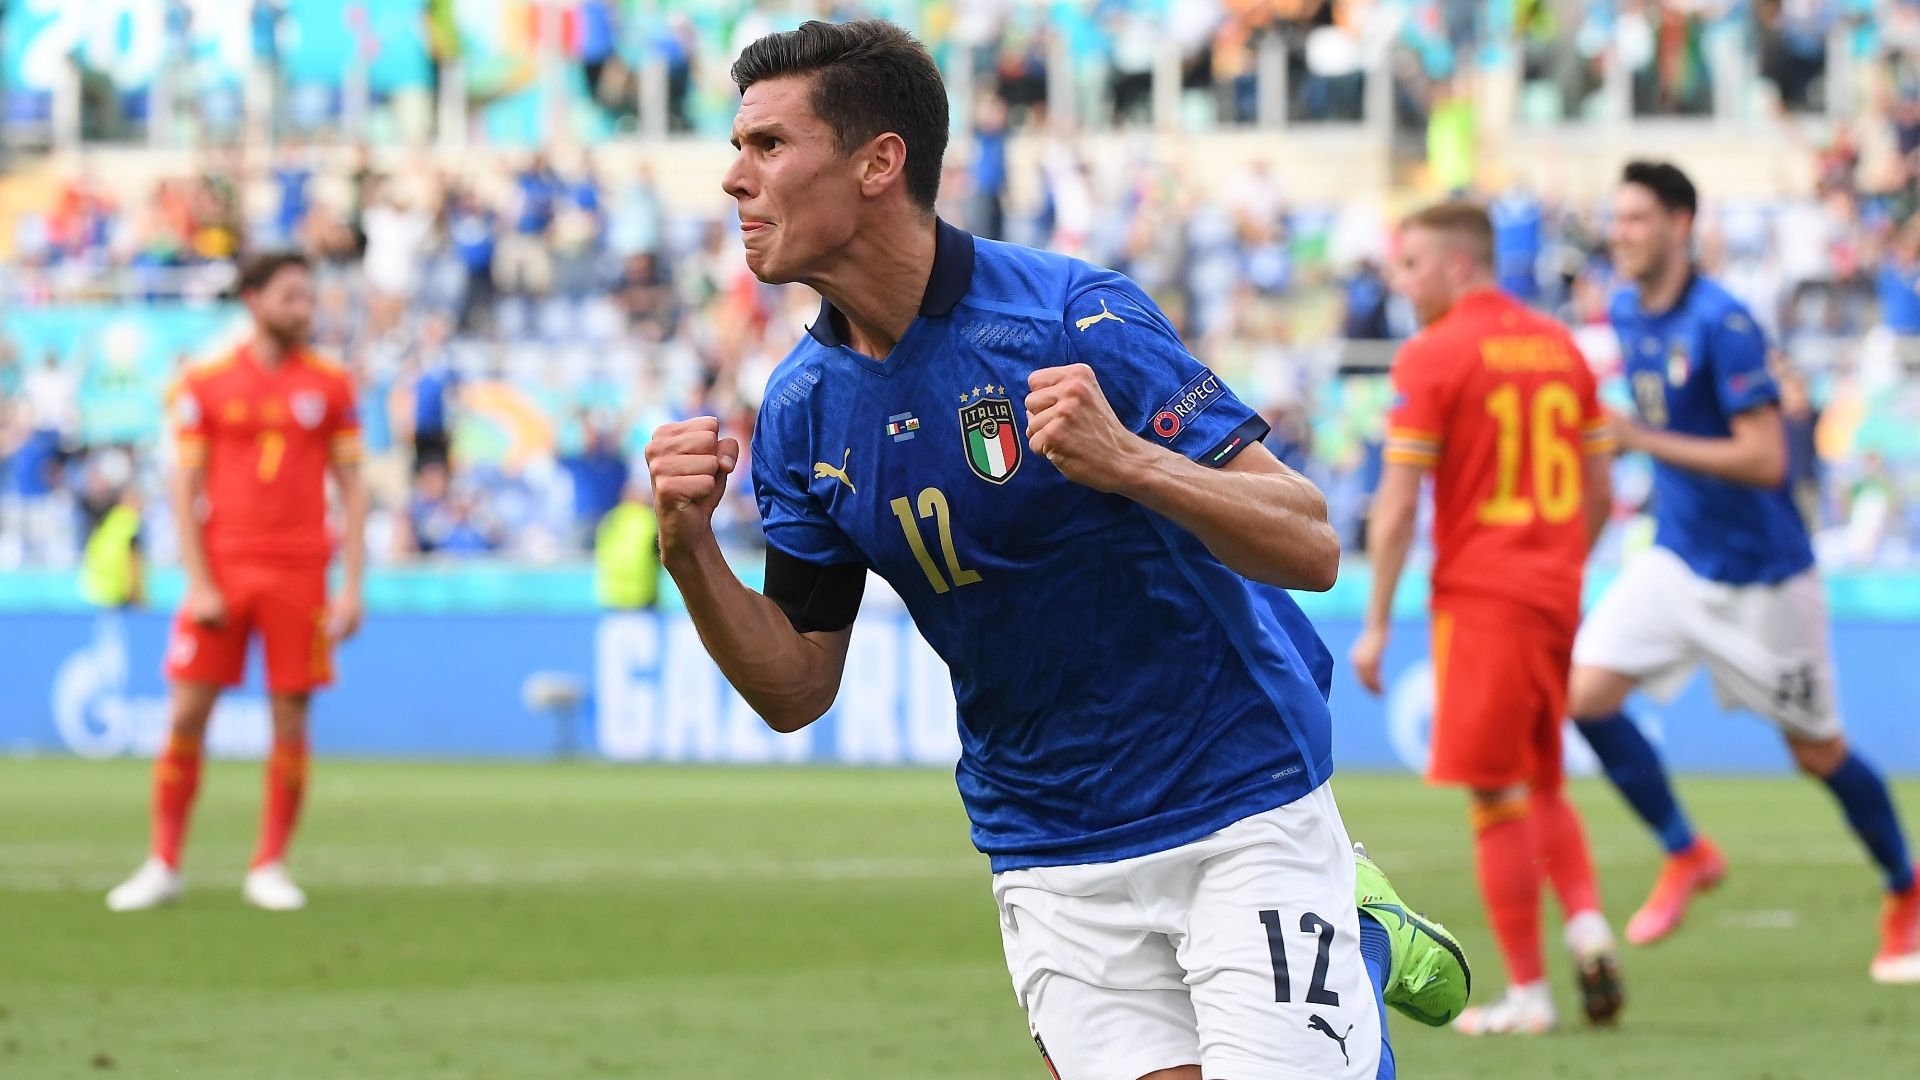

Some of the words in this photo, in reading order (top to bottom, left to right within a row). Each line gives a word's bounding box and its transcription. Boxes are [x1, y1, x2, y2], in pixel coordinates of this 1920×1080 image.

[964, 405, 1009, 424] ITALIA
[1173, 375, 1219, 418] RESPECT
[256, 429, 286, 484] 7
[1477, 380, 1584, 525] 16
[889, 487, 984, 595] 12
[1258, 909, 1340, 1008] 12
